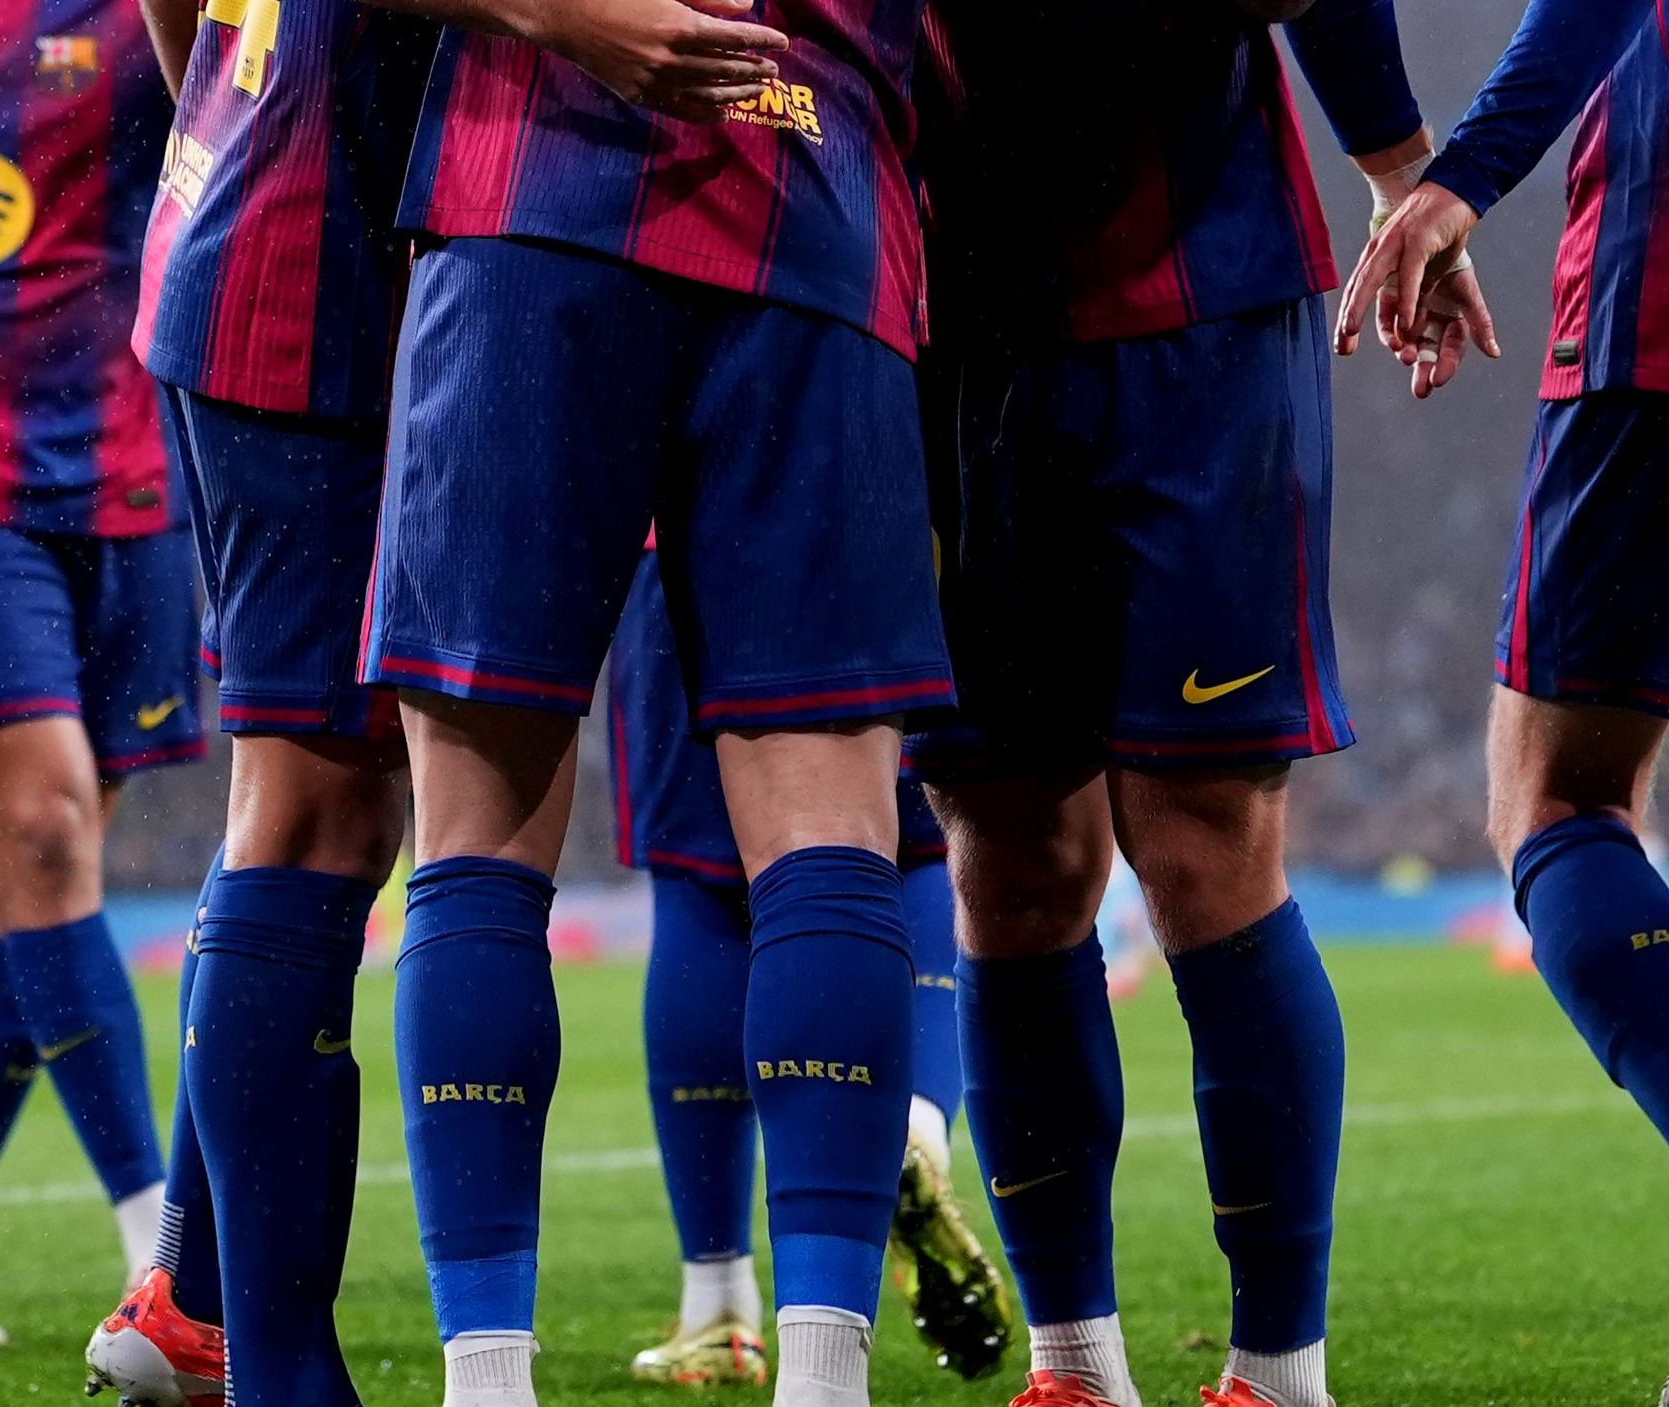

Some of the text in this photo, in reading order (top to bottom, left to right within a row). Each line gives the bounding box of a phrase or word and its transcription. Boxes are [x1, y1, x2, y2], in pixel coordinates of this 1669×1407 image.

[749, 113, 794, 129] Refugee
[756, 1059, 873, 1086] BARÇA
[421, 1082, 527, 1106] BARÇA
